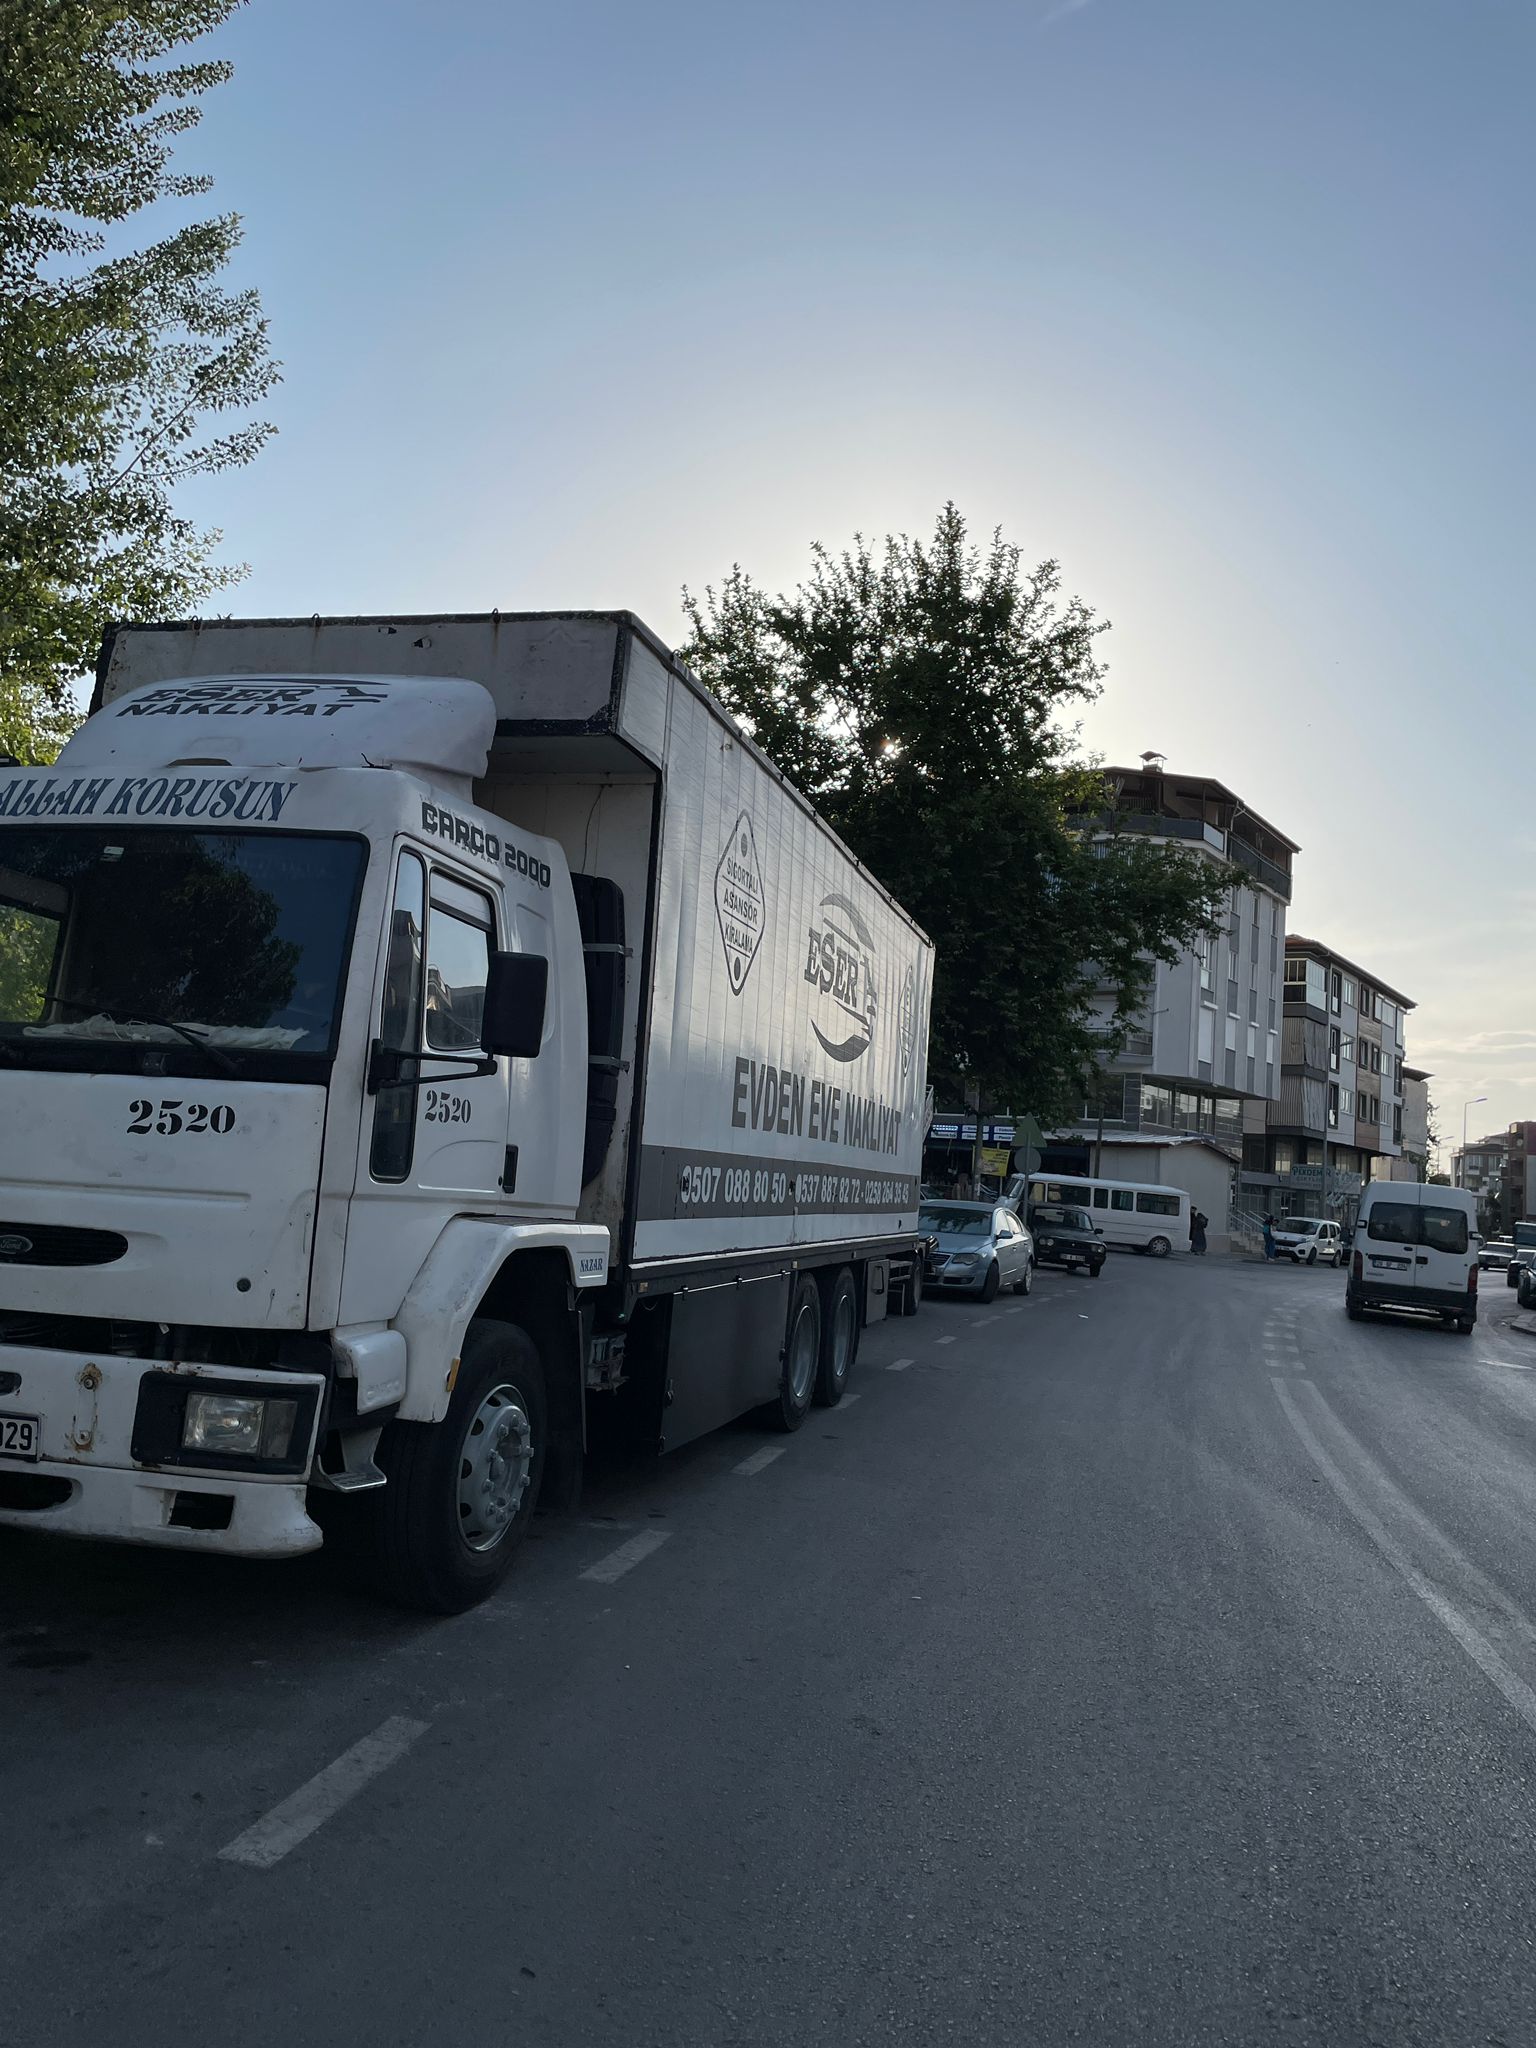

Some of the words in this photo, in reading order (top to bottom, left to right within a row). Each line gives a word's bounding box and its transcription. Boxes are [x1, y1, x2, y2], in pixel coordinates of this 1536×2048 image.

[0, 778, 114, 817] ALLAH
[103, 777, 298, 822] KORUSUN
[504, 842, 551, 888] 2000
[727, 855, 759, 895] SİGORTALI
[724, 887, 758, 925] ASANSÖR
[127, 1100, 236, 1135] 2520
[424, 1090, 472, 1123] 2520
[732, 1056, 805, 1137] EVDEN
[808, 1079, 841, 1143] EVE
[843, 1092, 901, 1156] NAKLİYAT
[681, 1165, 721, 1203] 0507
[725, 1168, 750, 1203] 088
[753, 1170, 768, 1203] 80
[771, 1172, 786, 1203] 50
[821, 1175, 838, 1203] 887
[839, 1177, 850, 1203] 82
[851, 1179, 860, 1204] 72
[580, 1258, 603, 1272] NAZAR
[0, 1421, 32, 1450] 29
